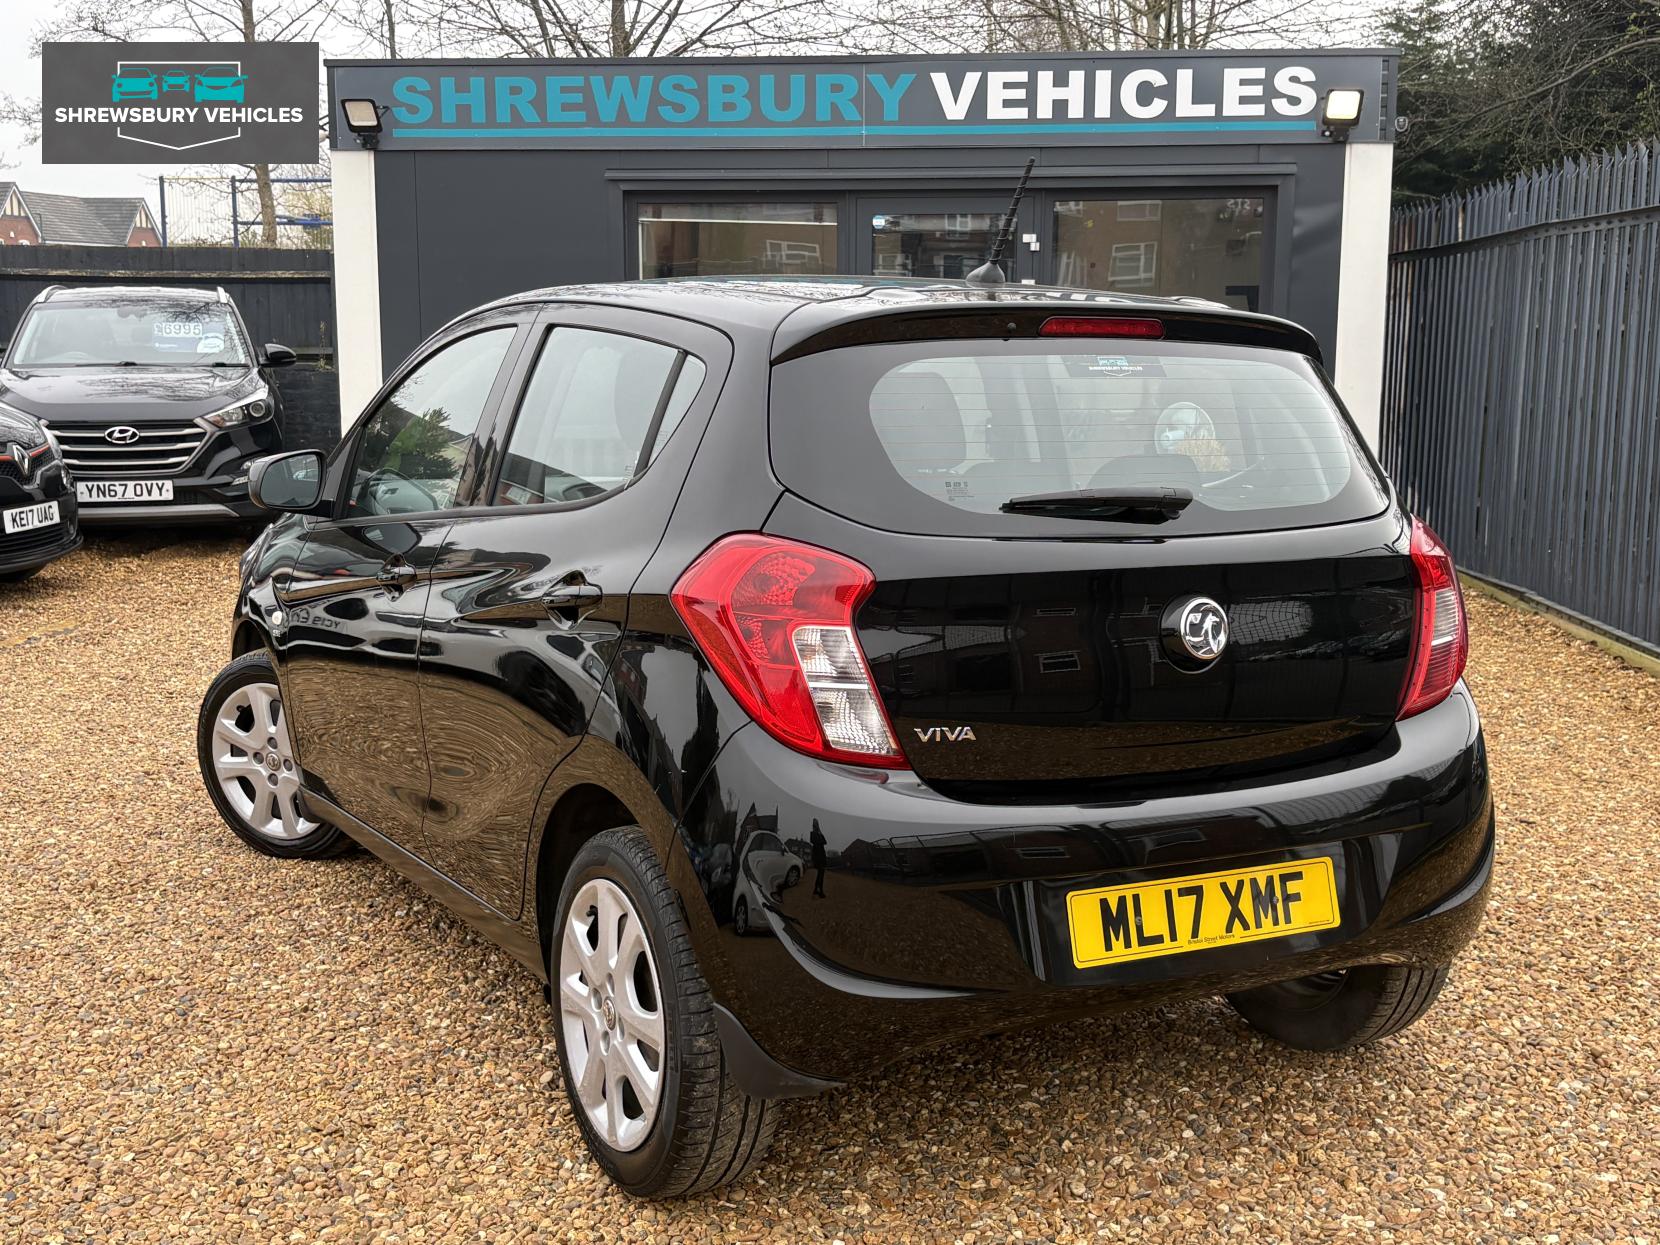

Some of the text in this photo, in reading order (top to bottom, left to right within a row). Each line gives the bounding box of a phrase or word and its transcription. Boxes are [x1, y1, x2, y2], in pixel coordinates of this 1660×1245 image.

[392, 66, 1318, 124] SHREWSBURY VEHICLES
[85, 483, 166, 499] YN67 OVY
[11, 505, 54, 529] KE17 UAG
[913, 726, 977, 743] VIVA
[1099, 871, 1304, 952] ML17 XMF
